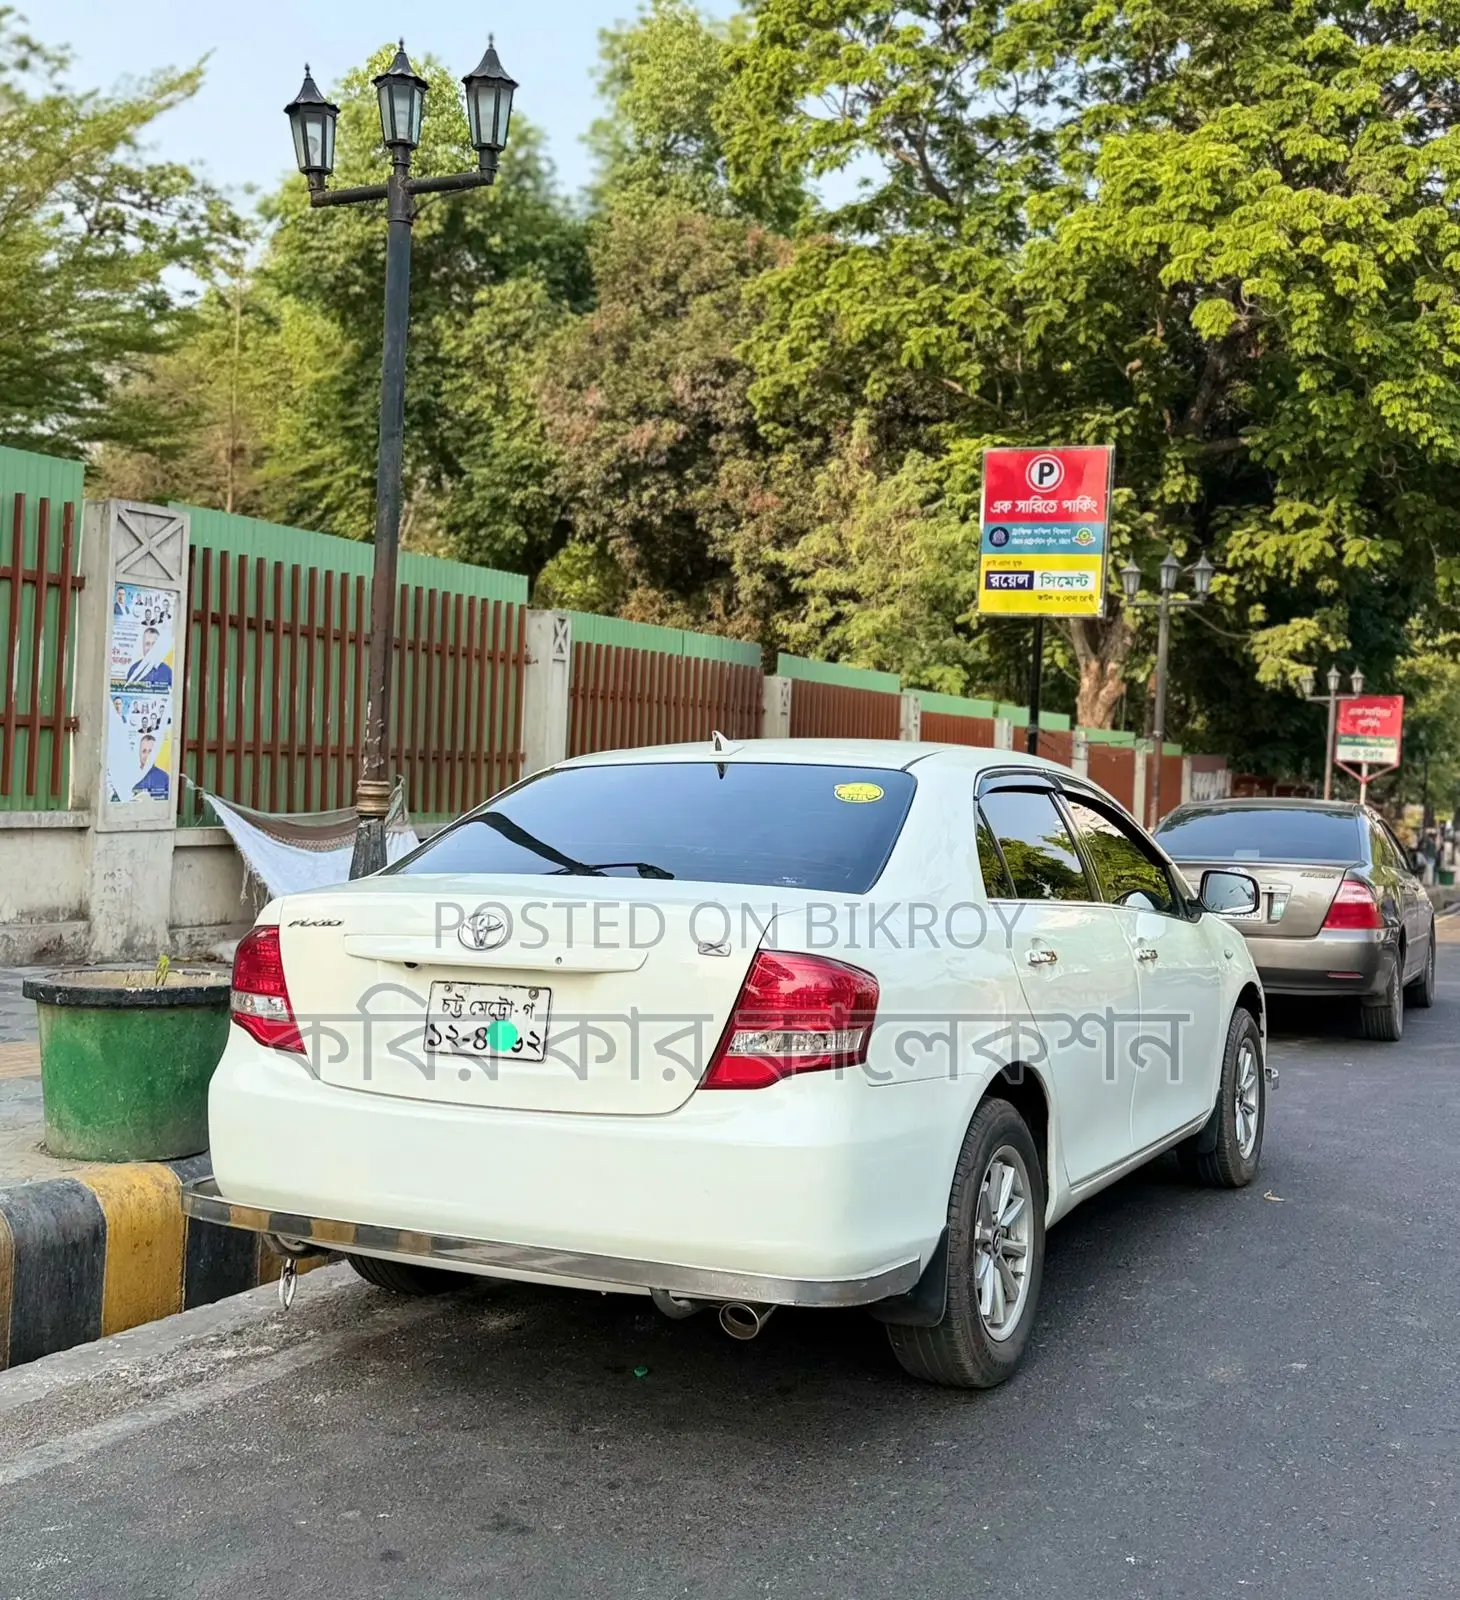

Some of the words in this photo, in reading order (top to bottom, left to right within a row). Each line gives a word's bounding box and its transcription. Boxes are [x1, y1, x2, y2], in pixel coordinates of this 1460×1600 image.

[1038, 462, 1055, 485] P
[991, 500, 1012, 513] এক
[1015, 495, 1058, 513] সারিতে
[1062, 495, 1099, 515] পার্কিং
[989, 574, 1029, 588] রয়েল
[1039, 572, 1090, 588] সিমেন্ট
